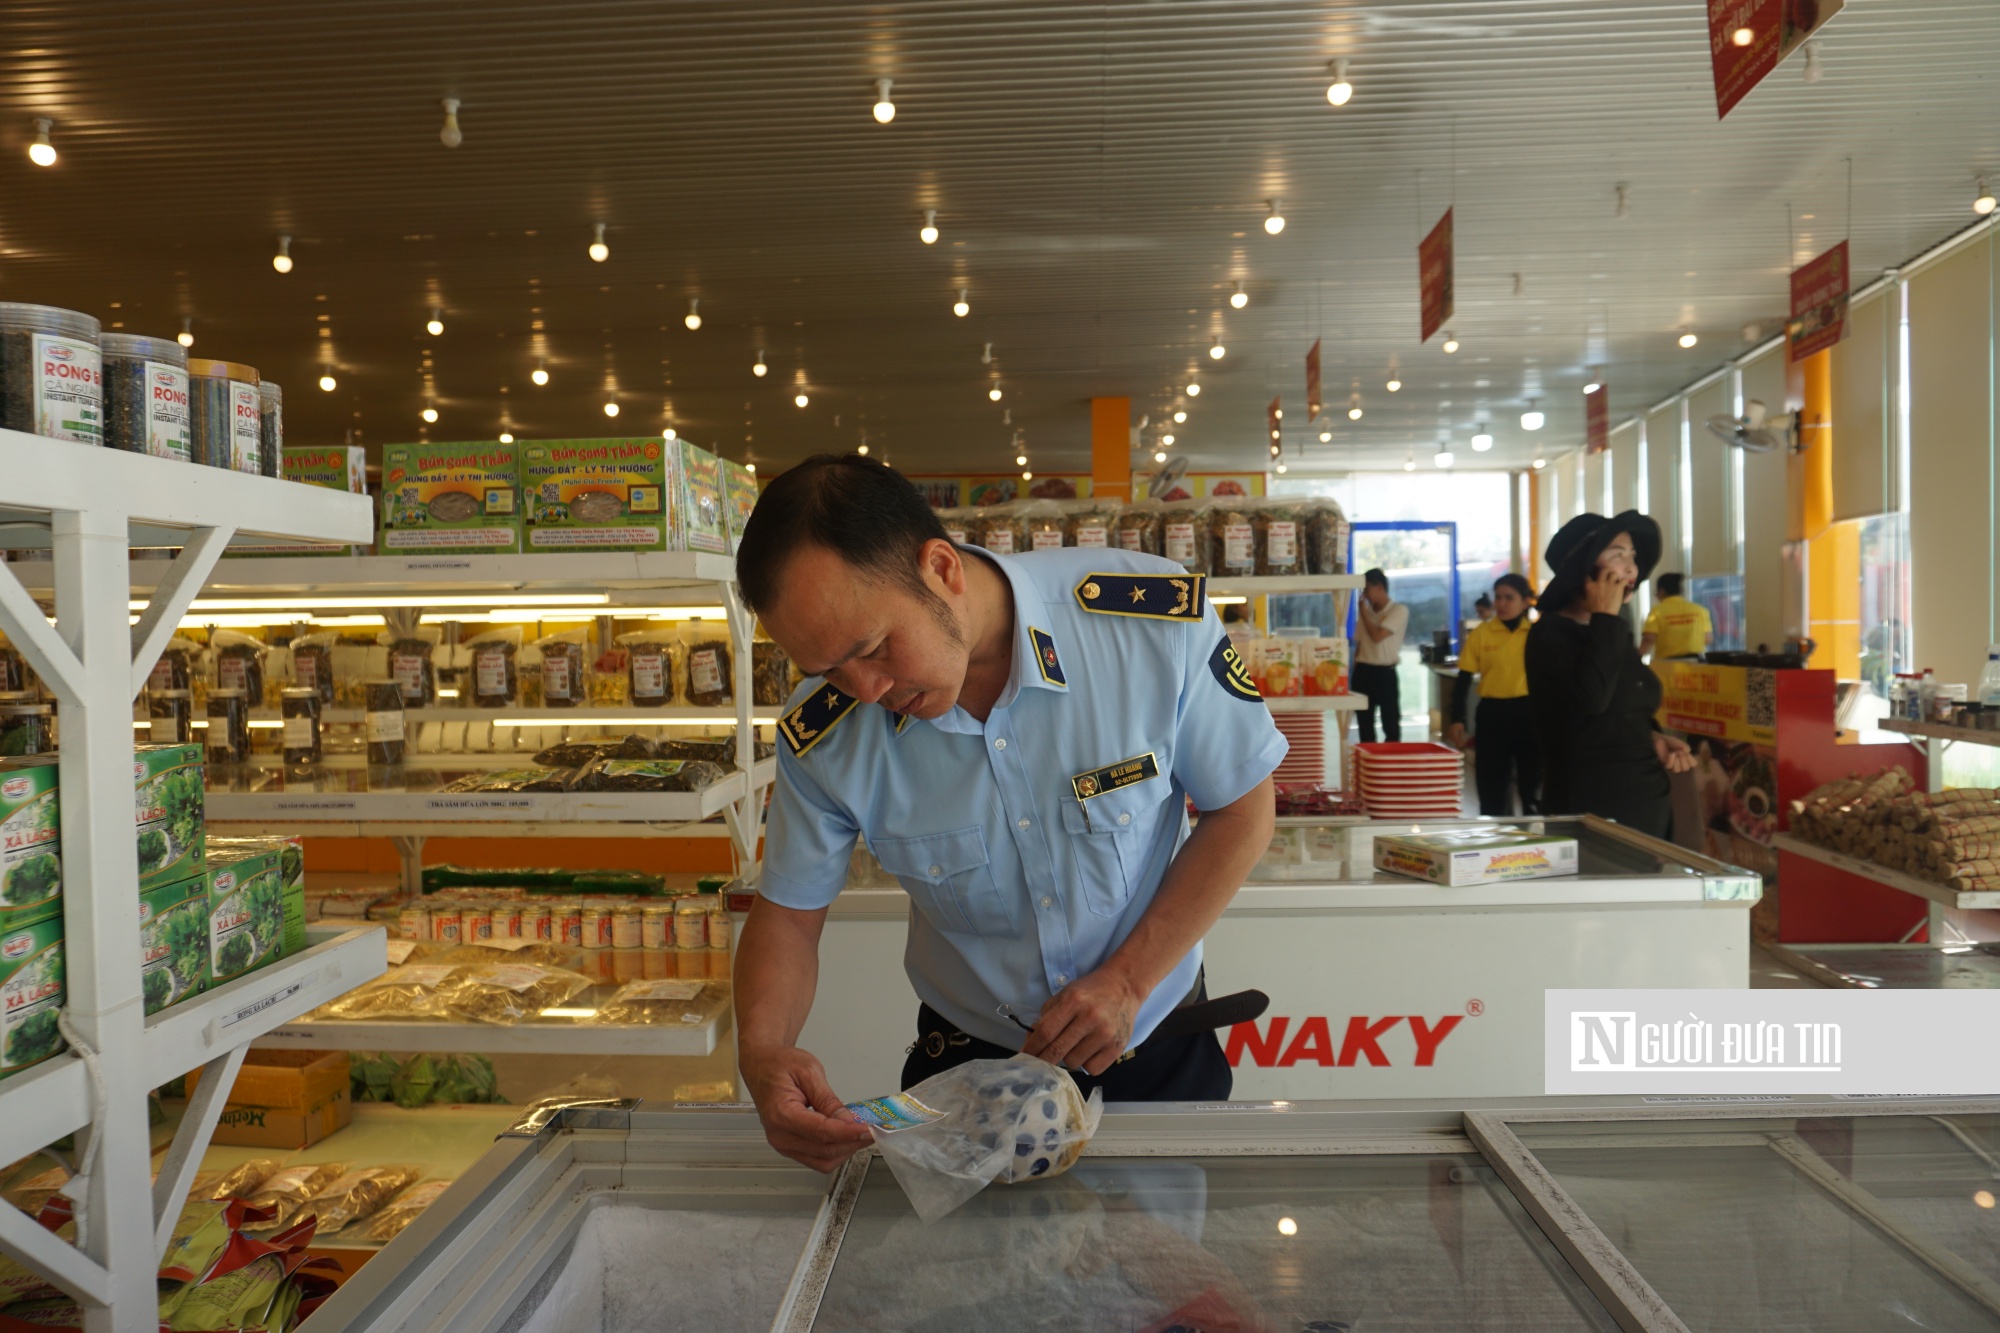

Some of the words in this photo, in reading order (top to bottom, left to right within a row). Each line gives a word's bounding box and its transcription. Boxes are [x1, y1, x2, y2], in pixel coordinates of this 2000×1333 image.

[44, 361, 91, 383] RONG
[44, 392, 77, 404] INSTANT
[153, 386, 187, 405] RONG
[153, 414, 178, 425] INSTANT
[417, 455, 444, 471] Bún
[479, 449, 512, 468] Thần
[551, 446, 576, 462] Bún
[609, 442, 641, 460] Thần
[430, 473, 447, 483] ĐẤT
[454, 472, 465, 482] LÝ
[468, 473, 482, 483] THỊ
[557, 464, 577, 474] ĐẤT
[585, 463, 597, 474] LÝ
[601, 464, 616, 475] THỊ
[142, 806, 167, 821] LÁCH
[3, 818, 34, 832] RONG
[5, 832, 23, 849] XÀ
[26, 827, 57, 844] LÁCH
[216, 904, 237, 918] RONG
[217, 917, 229, 931] XÀ
[231, 911, 252, 926] LÁCH
[145, 943, 171, 962] LÁCH
[6, 992, 24, 1010] XÀ
[28, 981, 60, 1001] LÁCH
